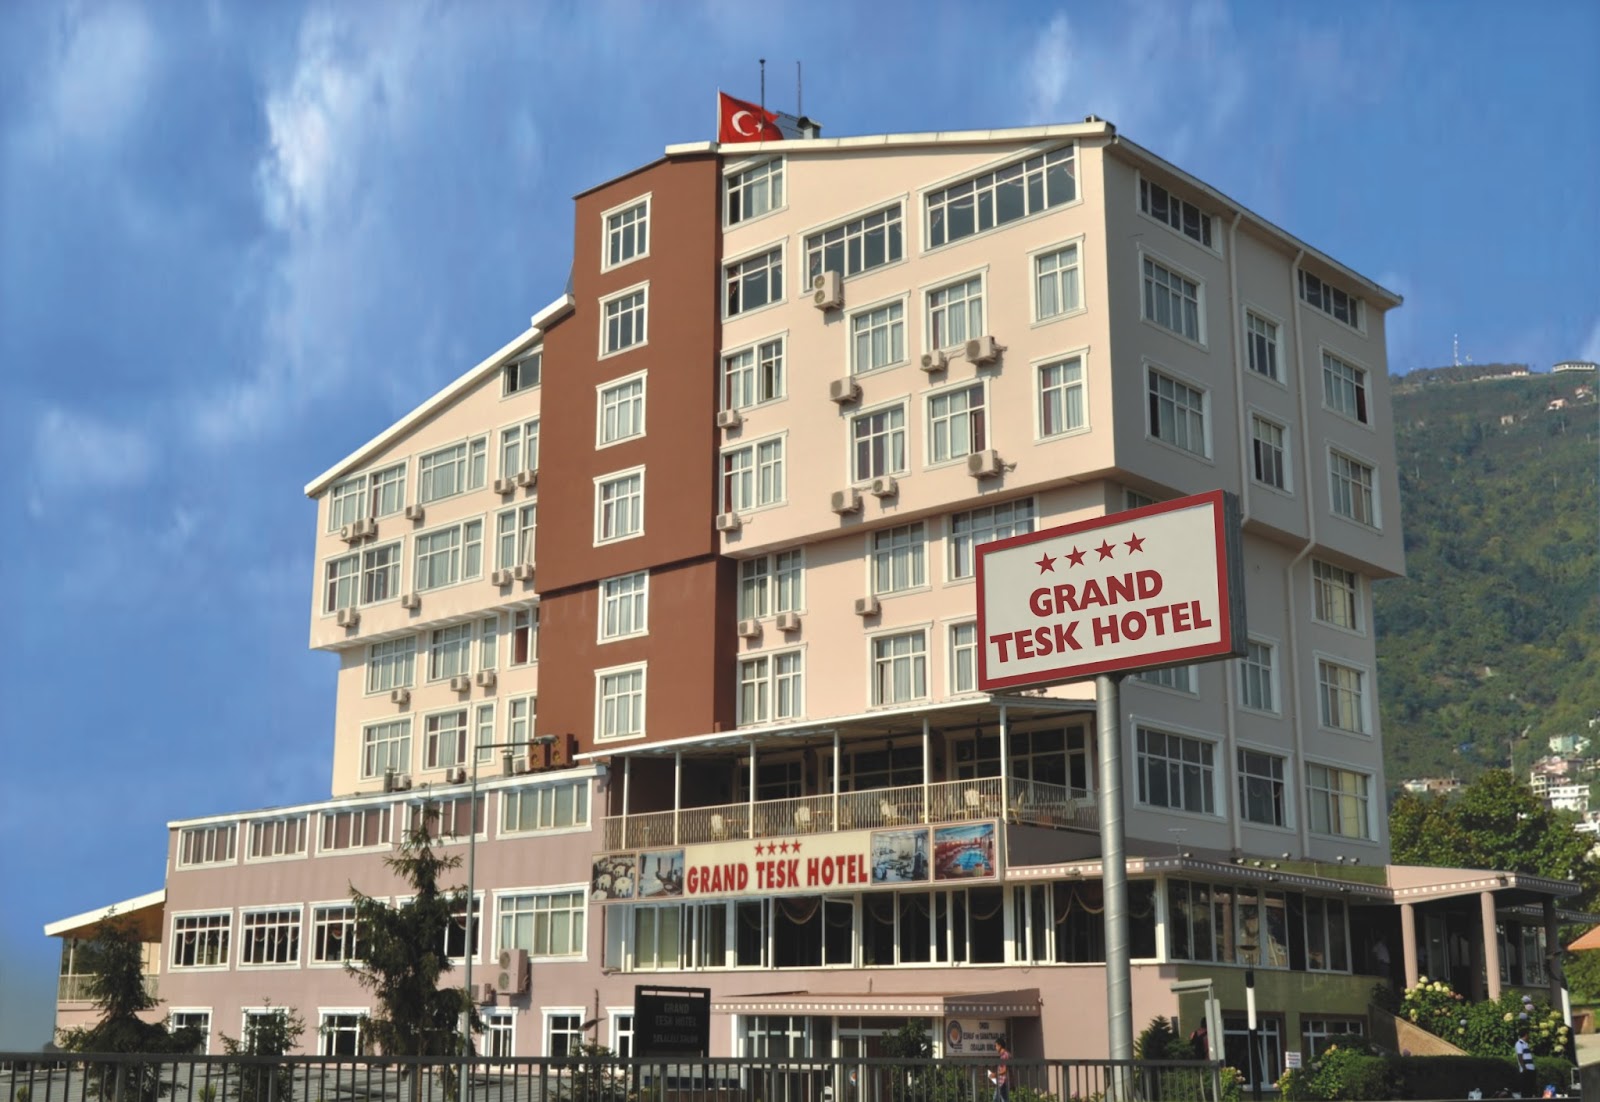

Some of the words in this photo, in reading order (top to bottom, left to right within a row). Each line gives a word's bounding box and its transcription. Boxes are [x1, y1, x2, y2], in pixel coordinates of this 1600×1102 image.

[1029, 569, 1163, 617] GRAND
[990, 620, 1083, 663] TESK
[1091, 600, 1212, 647] HOTEL
[687, 862, 749, 894] GRAND
[756, 858, 800, 889] TESK
[807, 854, 868, 886] HOTEL
[664, 1002, 690, 1014] GRAND
